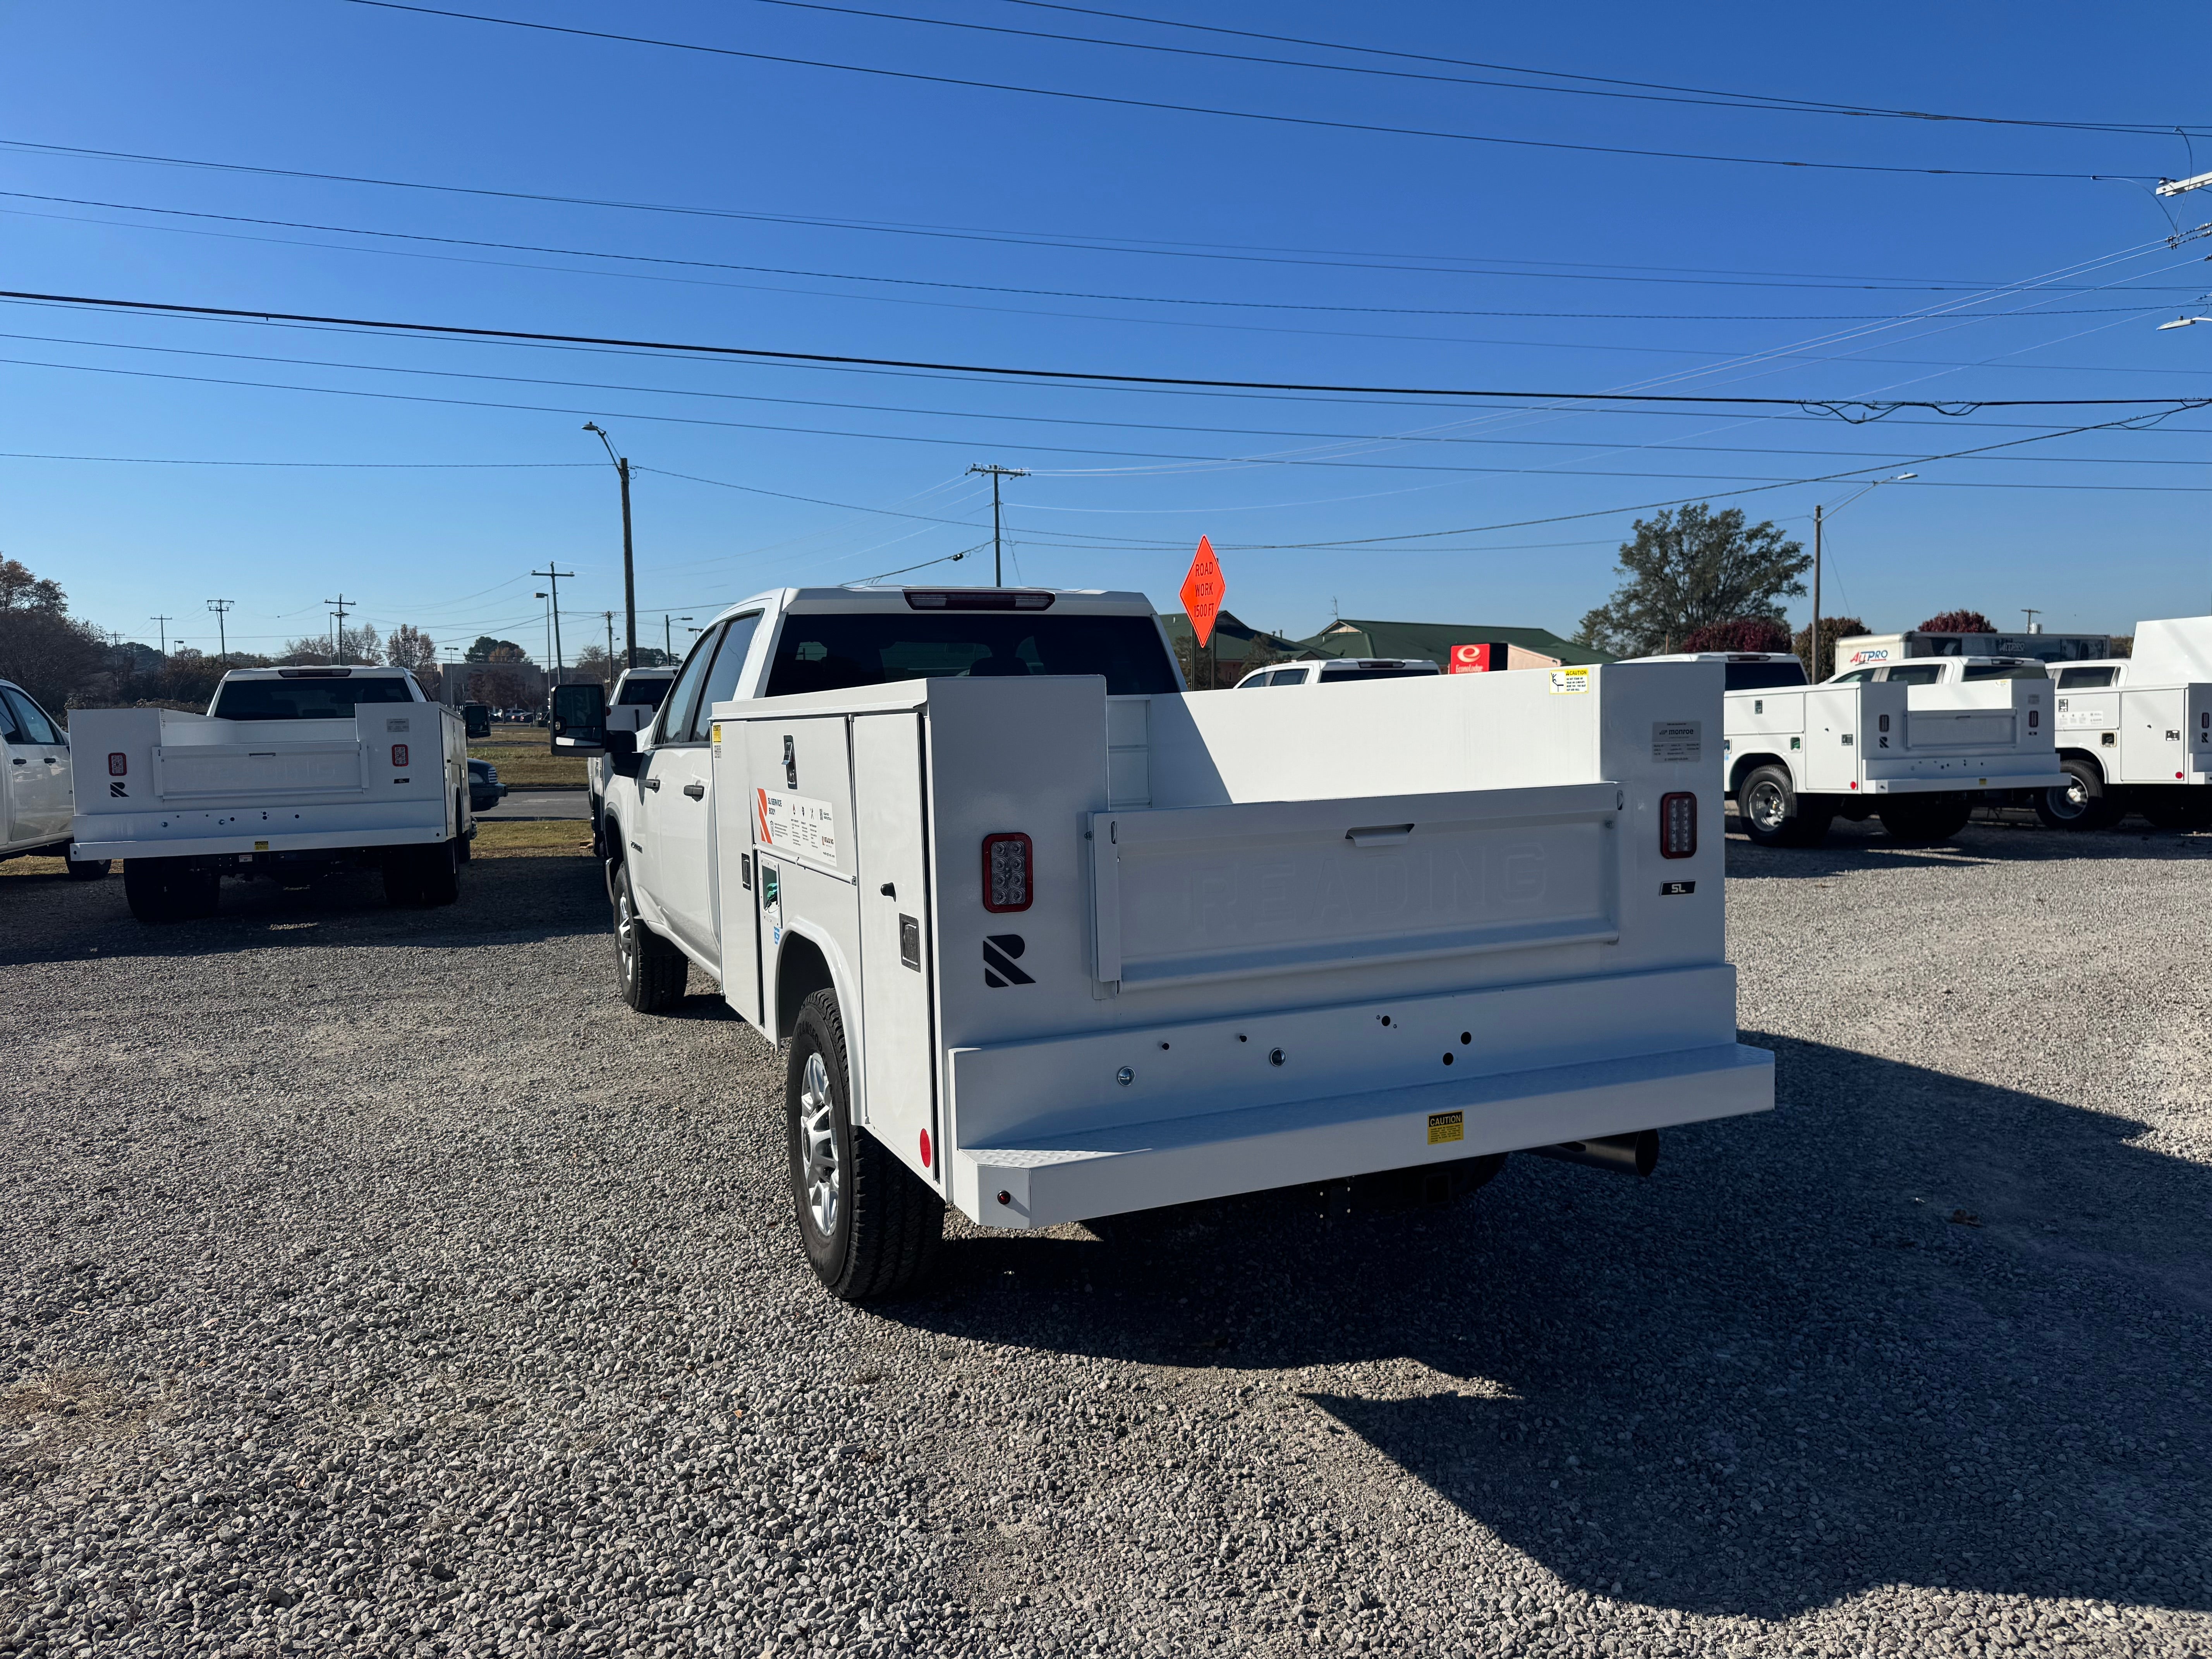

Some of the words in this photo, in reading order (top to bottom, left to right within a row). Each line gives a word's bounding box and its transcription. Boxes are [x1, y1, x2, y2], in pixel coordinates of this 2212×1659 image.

[1195, 562, 1213, 577] ROAD
[1195, 582, 1213, 597] WORK
[1194, 604, 1207, 618] 1500
[1208, 603, 1214, 617] FT
[1187, 843, 1548, 930] READING
[1671, 883, 1686, 893] SL
[1430, 1115, 1461, 1126] CAUTION
